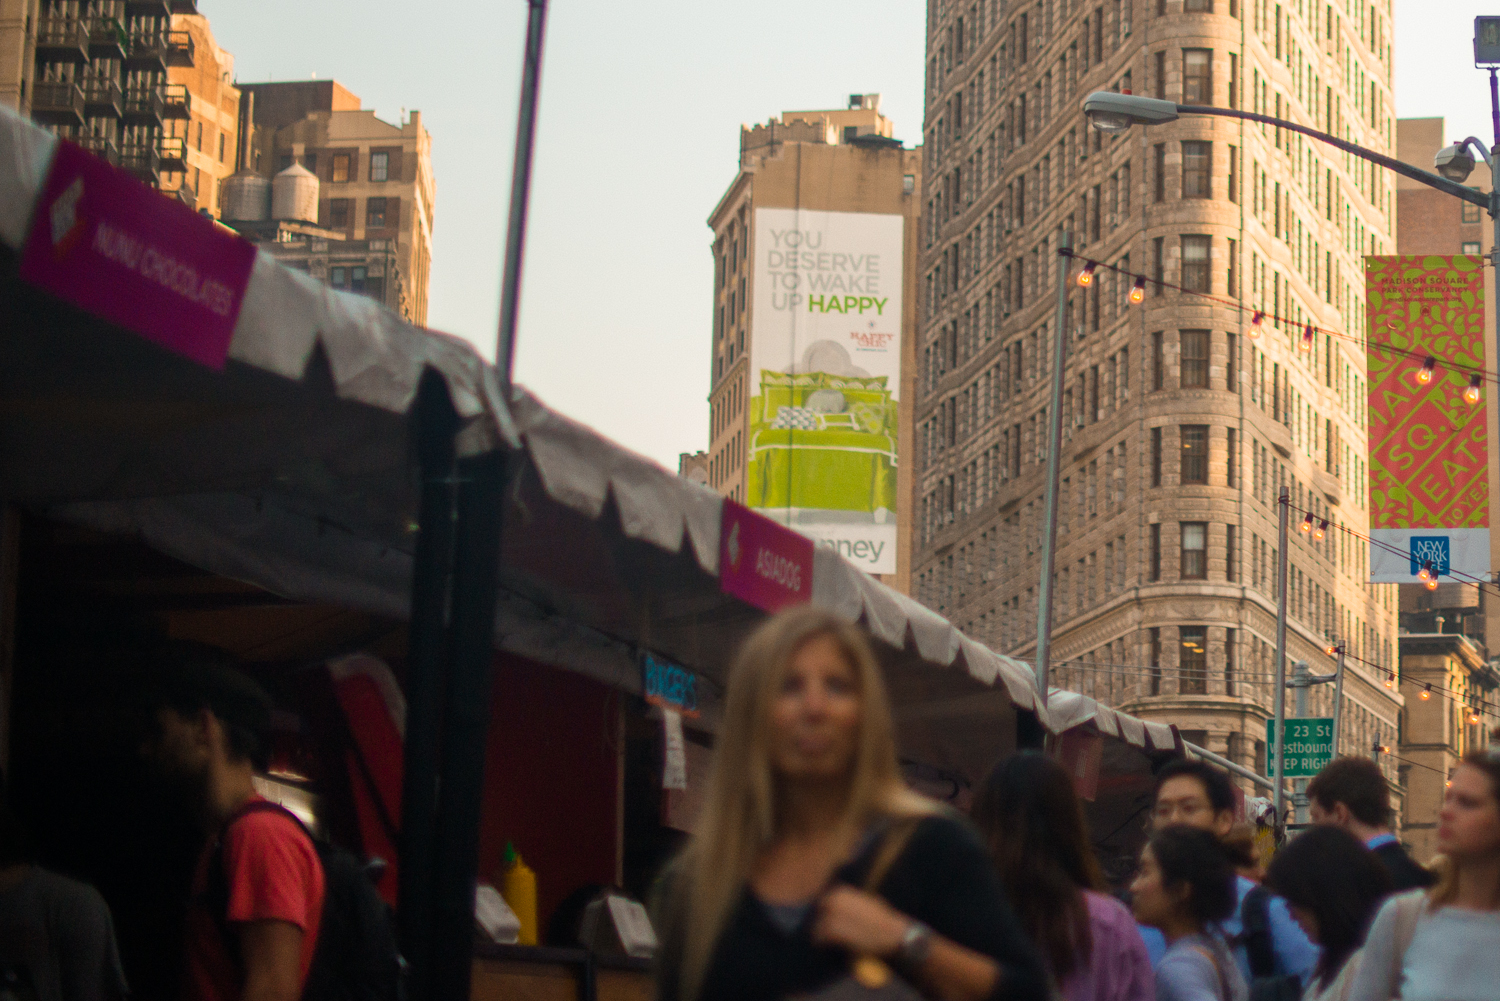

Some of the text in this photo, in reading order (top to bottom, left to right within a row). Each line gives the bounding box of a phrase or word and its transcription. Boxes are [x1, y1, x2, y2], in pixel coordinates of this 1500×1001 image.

[770, 229, 822, 249] YOU
[768, 250, 880, 273] DESERVE
[768, 271, 880, 294] TO WAKE
[1381, 277, 1469, 285] MADISON SQUARE
[1406, 286, 1469, 294] CONSERVANCY
[772, 292, 888, 315] UP HAPPY
[1445, 474, 1489, 526] 10 YEA
[1417, 540, 1445, 551] NEW
[1413, 550, 1447, 562] YORK
[756, 547, 801, 591] ASIADOG
[1293, 725, 1310, 738] 23
[1316, 724, 1331, 737] St
[1269, 758, 1334, 770] KEP RIGH
